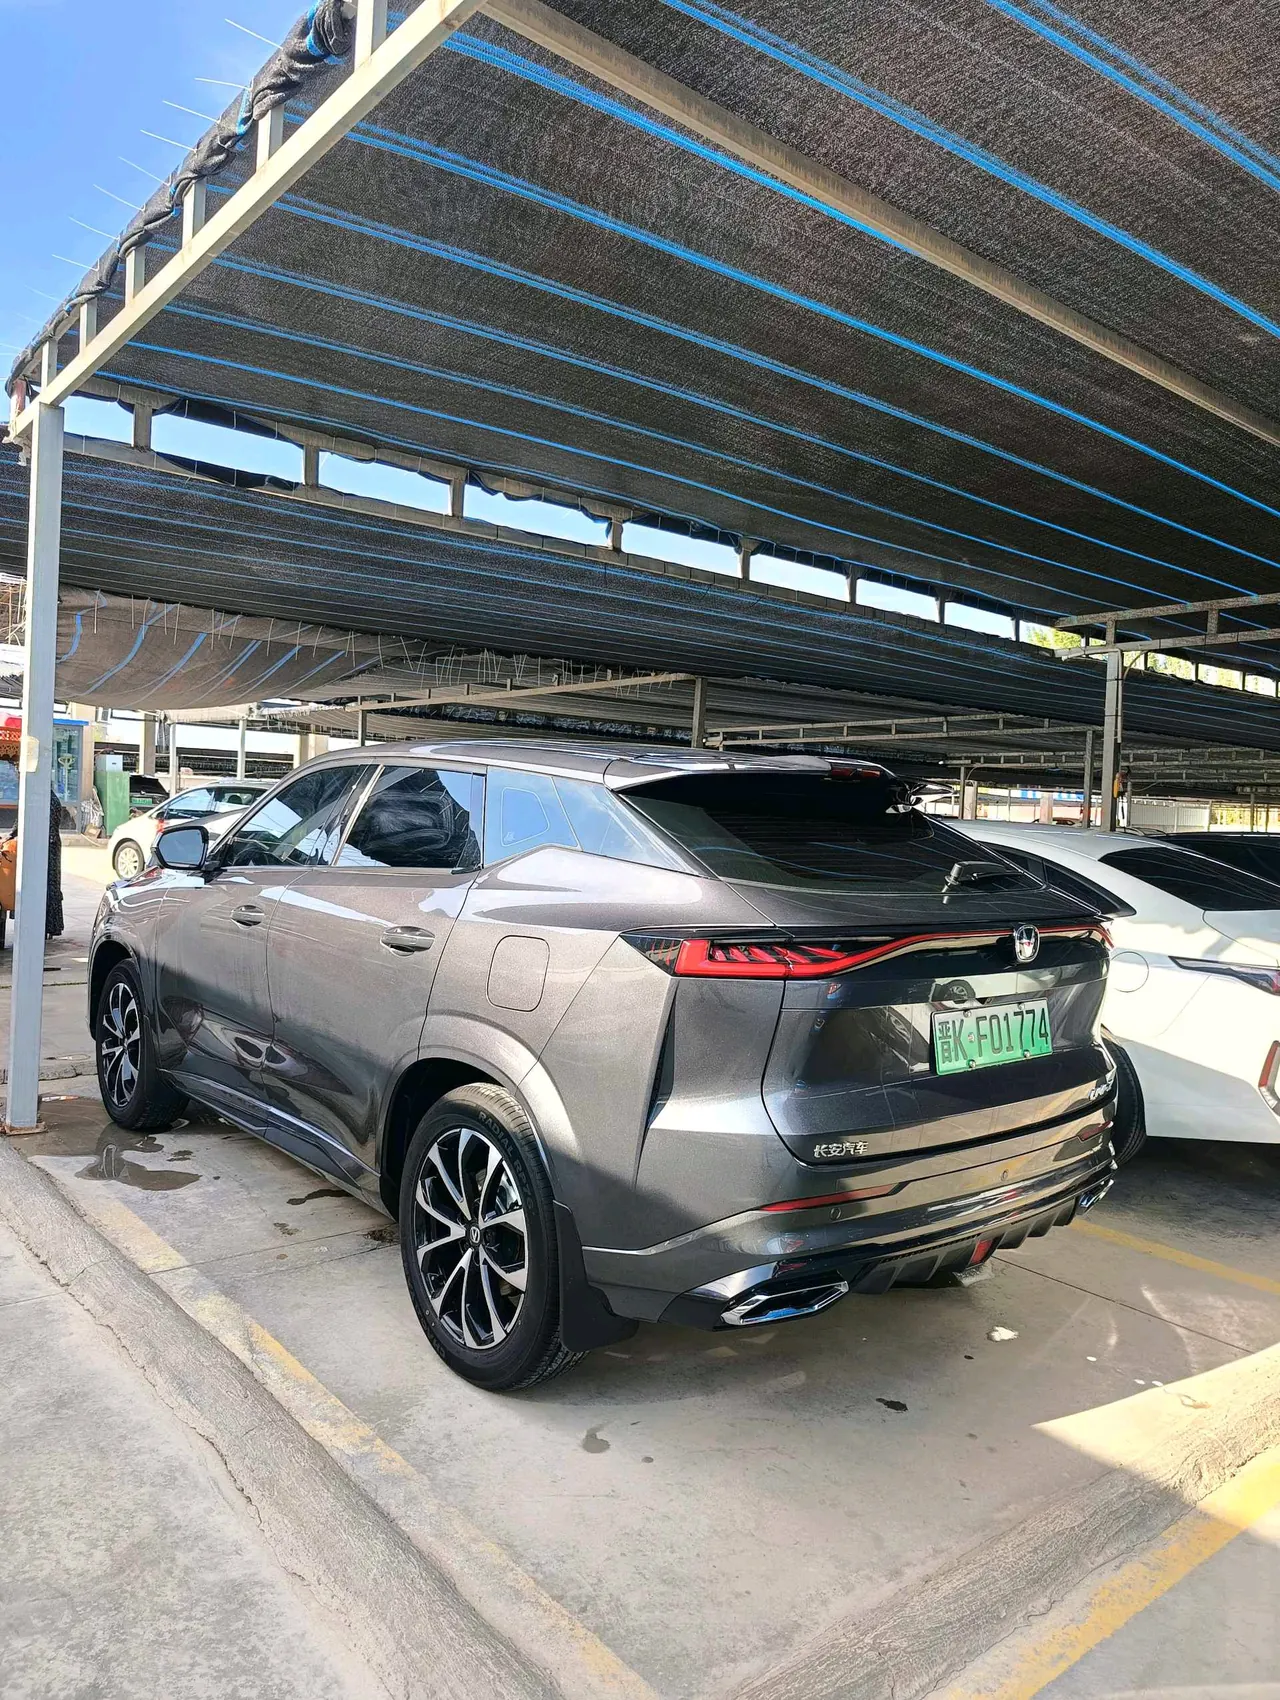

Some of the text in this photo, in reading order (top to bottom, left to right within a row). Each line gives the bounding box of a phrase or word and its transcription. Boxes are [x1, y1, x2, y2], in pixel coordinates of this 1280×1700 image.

[478, 1111, 514, 1157] RADIAL
[813, 1140, 869, 1158] 长安汽车
